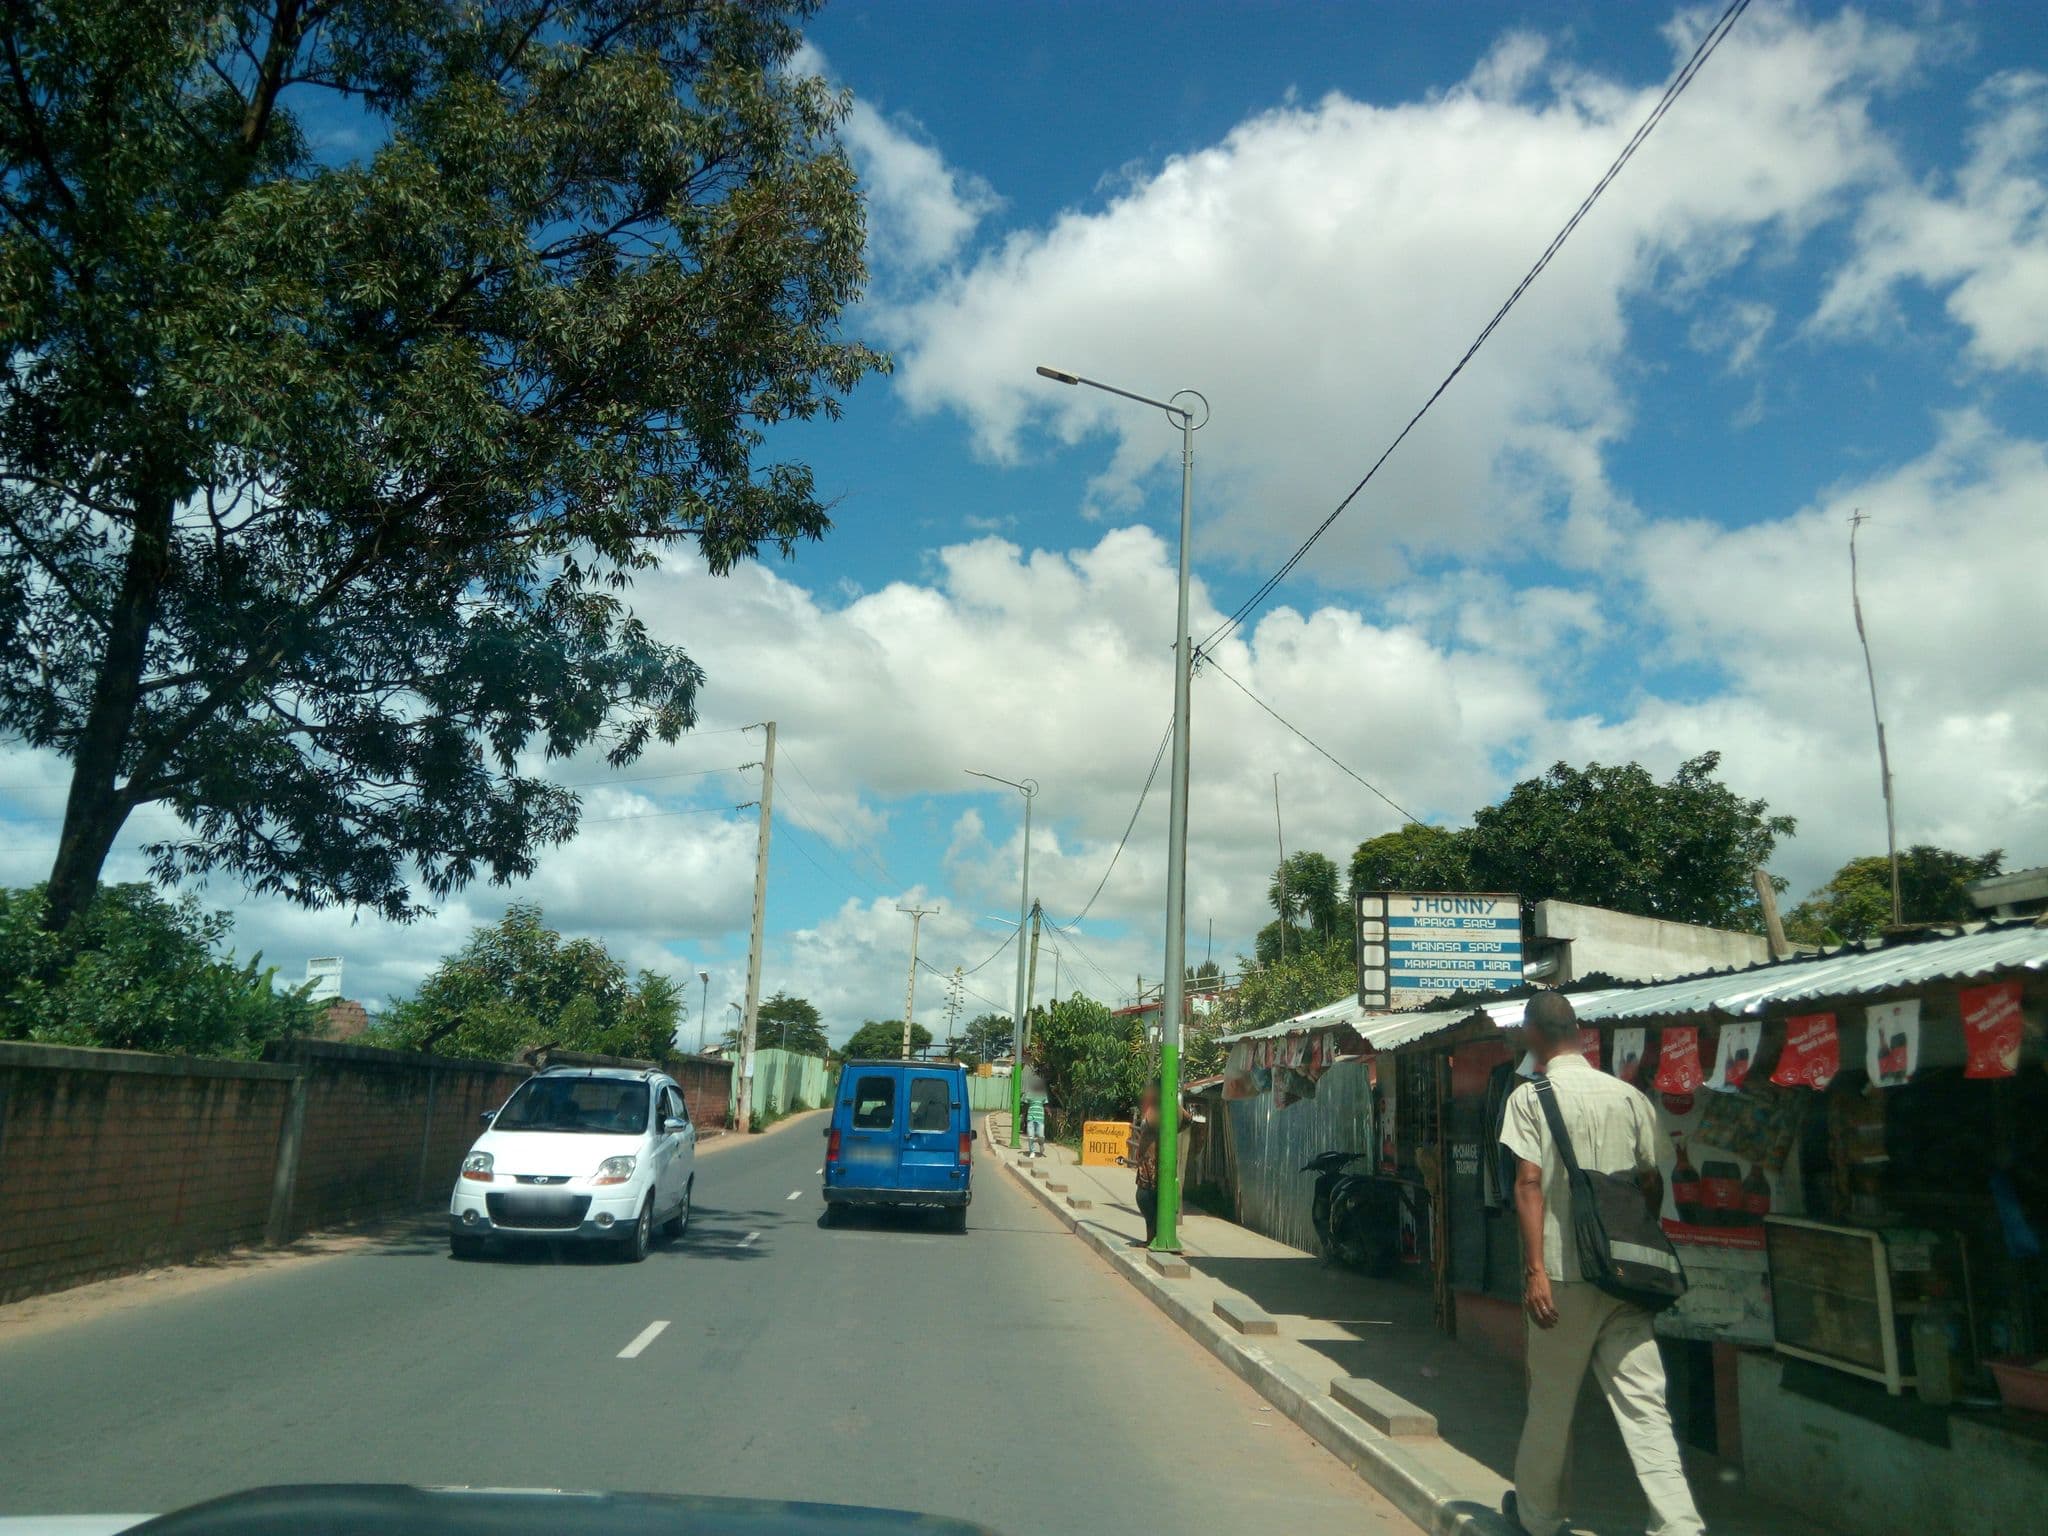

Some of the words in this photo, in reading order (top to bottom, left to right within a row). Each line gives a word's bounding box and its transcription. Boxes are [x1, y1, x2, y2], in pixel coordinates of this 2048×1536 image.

[1411, 897, 1497, 914] JHONNY
[1414, 917, 1456, 927] MPAKA
[1463, 919, 1496, 928] SARY
[1411, 941, 1462, 952] MANASA
[1469, 942, 1502, 952] SARY
[1404, 959, 1476, 970] MAMPIDITRA
[1483, 960, 1511, 971] HIRA
[1419, 978, 1496, 989] PHOTOCOPIE
[1089, 1141, 1119, 1154] HOTEL
